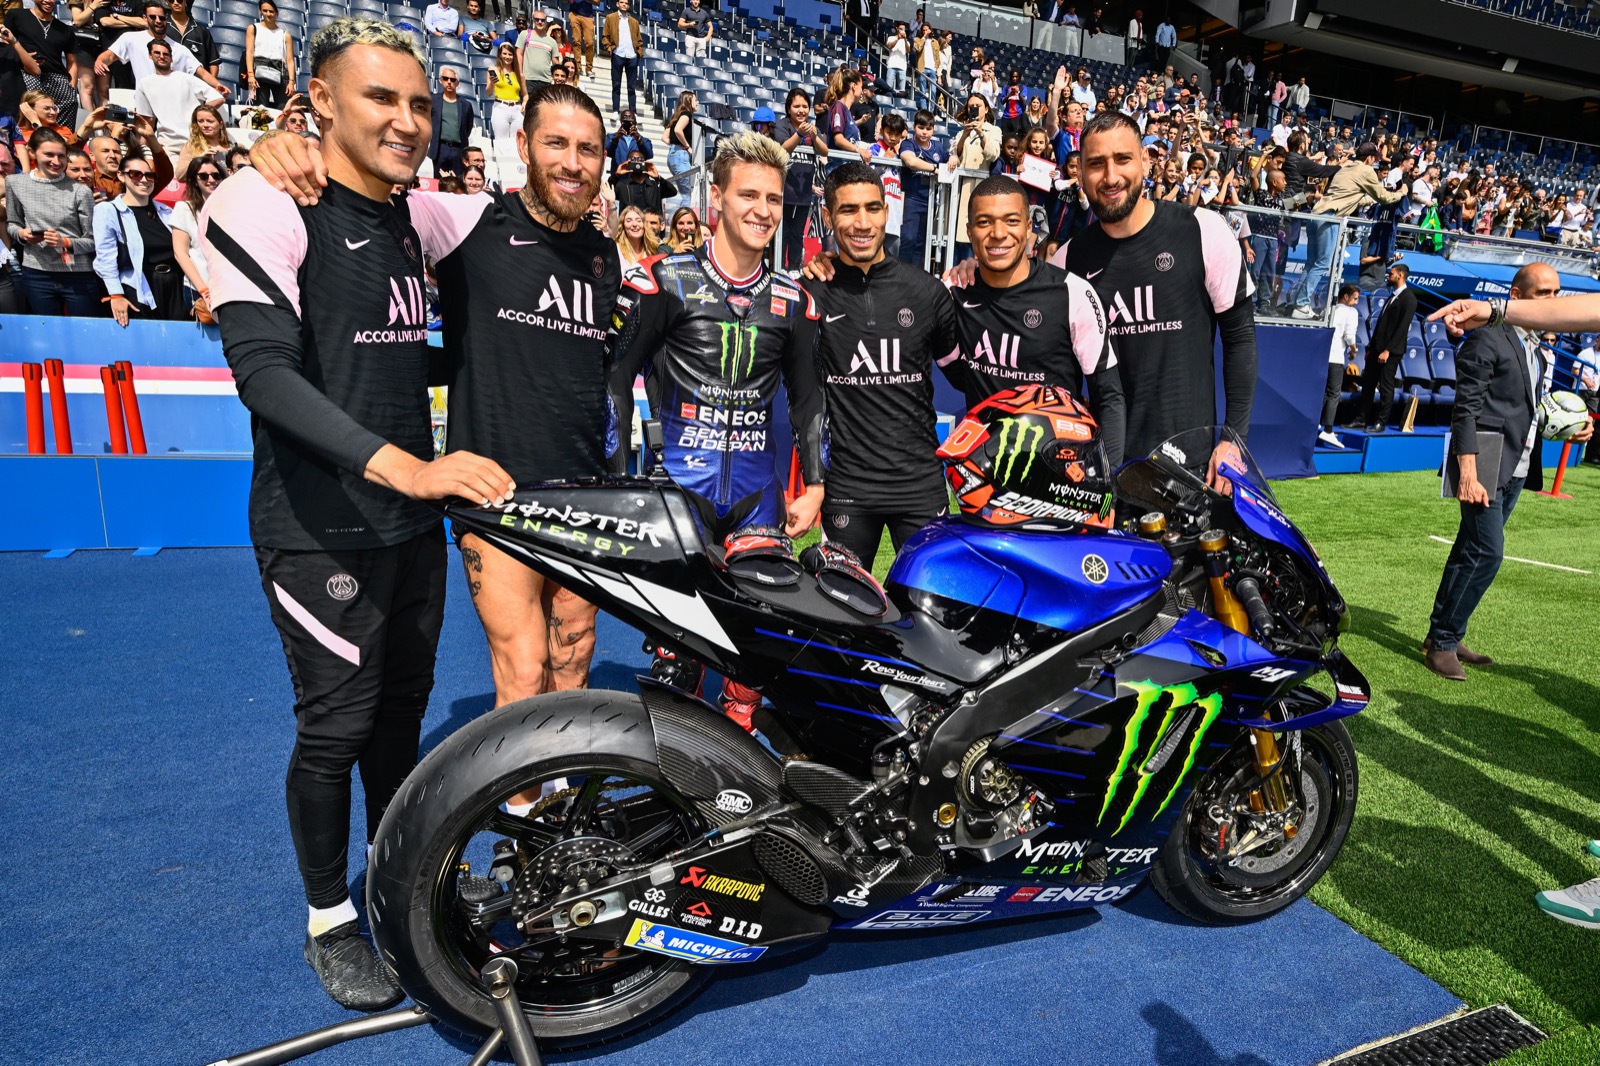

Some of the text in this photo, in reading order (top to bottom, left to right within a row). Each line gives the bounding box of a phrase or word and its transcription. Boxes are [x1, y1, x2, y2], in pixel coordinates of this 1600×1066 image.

[701, 260, 728, 291] YAMAHA
[1417, 277, 1444, 287] PARIS
[497, 307, 545, 328] ACCOR
[547, 318, 571, 334] LIVE
[1118, 325, 1136, 335] LIVE
[1138, 321, 1182, 333] LIMITLESS
[353, 330, 397, 343] ACCOR
[398, 330, 413, 342] LIVE
[826, 373, 922, 386] ACCOR LIVE LIMITLESS
[981, 364, 998, 376] LIVE
[1000, 368, 1045, 381] LIMITLESS
[699, 406, 767, 426] ENEOS
[683, 426, 766, 441] SEMAKIN
[1056, 419, 1089, 436] BS
[678, 435, 765, 452] DI DEPAN
[1048, 482, 1102, 504] MONSTER
[989, 491, 1087, 522] SCORPION
[1055, 496, 1093, 509] ENERGY
[500, 514, 636, 556] ENERGY
[1335, 742, 1351, 769] 120/70
[718, 793, 749, 810] BMC
[1015, 838, 1158, 864] MONTER
[1022, 859, 1128, 874] ENERY
[833, 896, 869, 907] RCB
[1033, 884, 1137, 902] ENEOS
[628, 899, 670, 918] GILLES
[680, 913, 712, 924] FURUKAWA
[682, 918, 708, 927] ELECTRIC
[668, 937, 753, 959] MICHELIN
